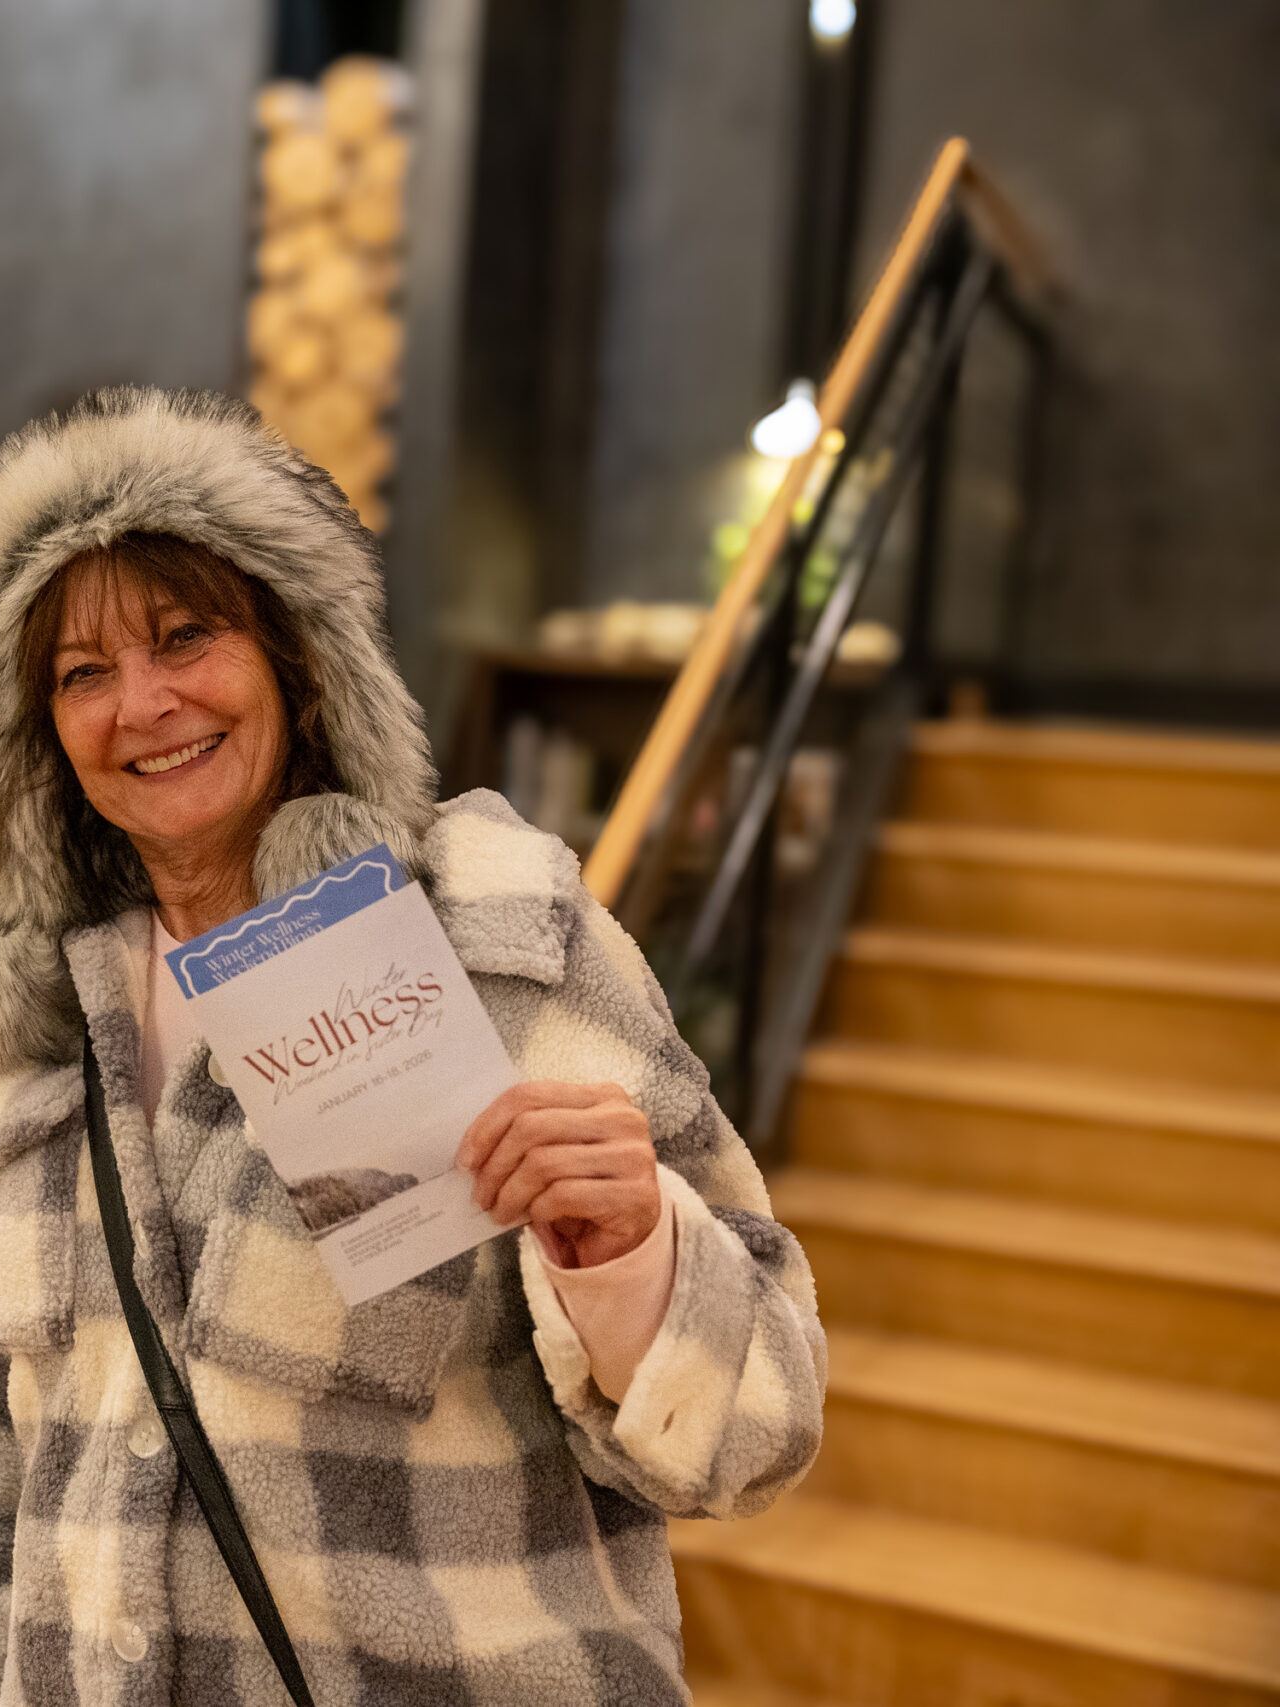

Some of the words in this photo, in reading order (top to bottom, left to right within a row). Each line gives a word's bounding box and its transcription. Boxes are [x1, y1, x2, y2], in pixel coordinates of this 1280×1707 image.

[205, 941, 255, 972] Winter
[256, 911, 321, 946] Wellness
[333, 961, 407, 1025] Winter
[243, 972, 443, 1084] Wellness
[317, 1081, 369, 1114] JANUARY
[402, 1050, 433, 1072] 2026
